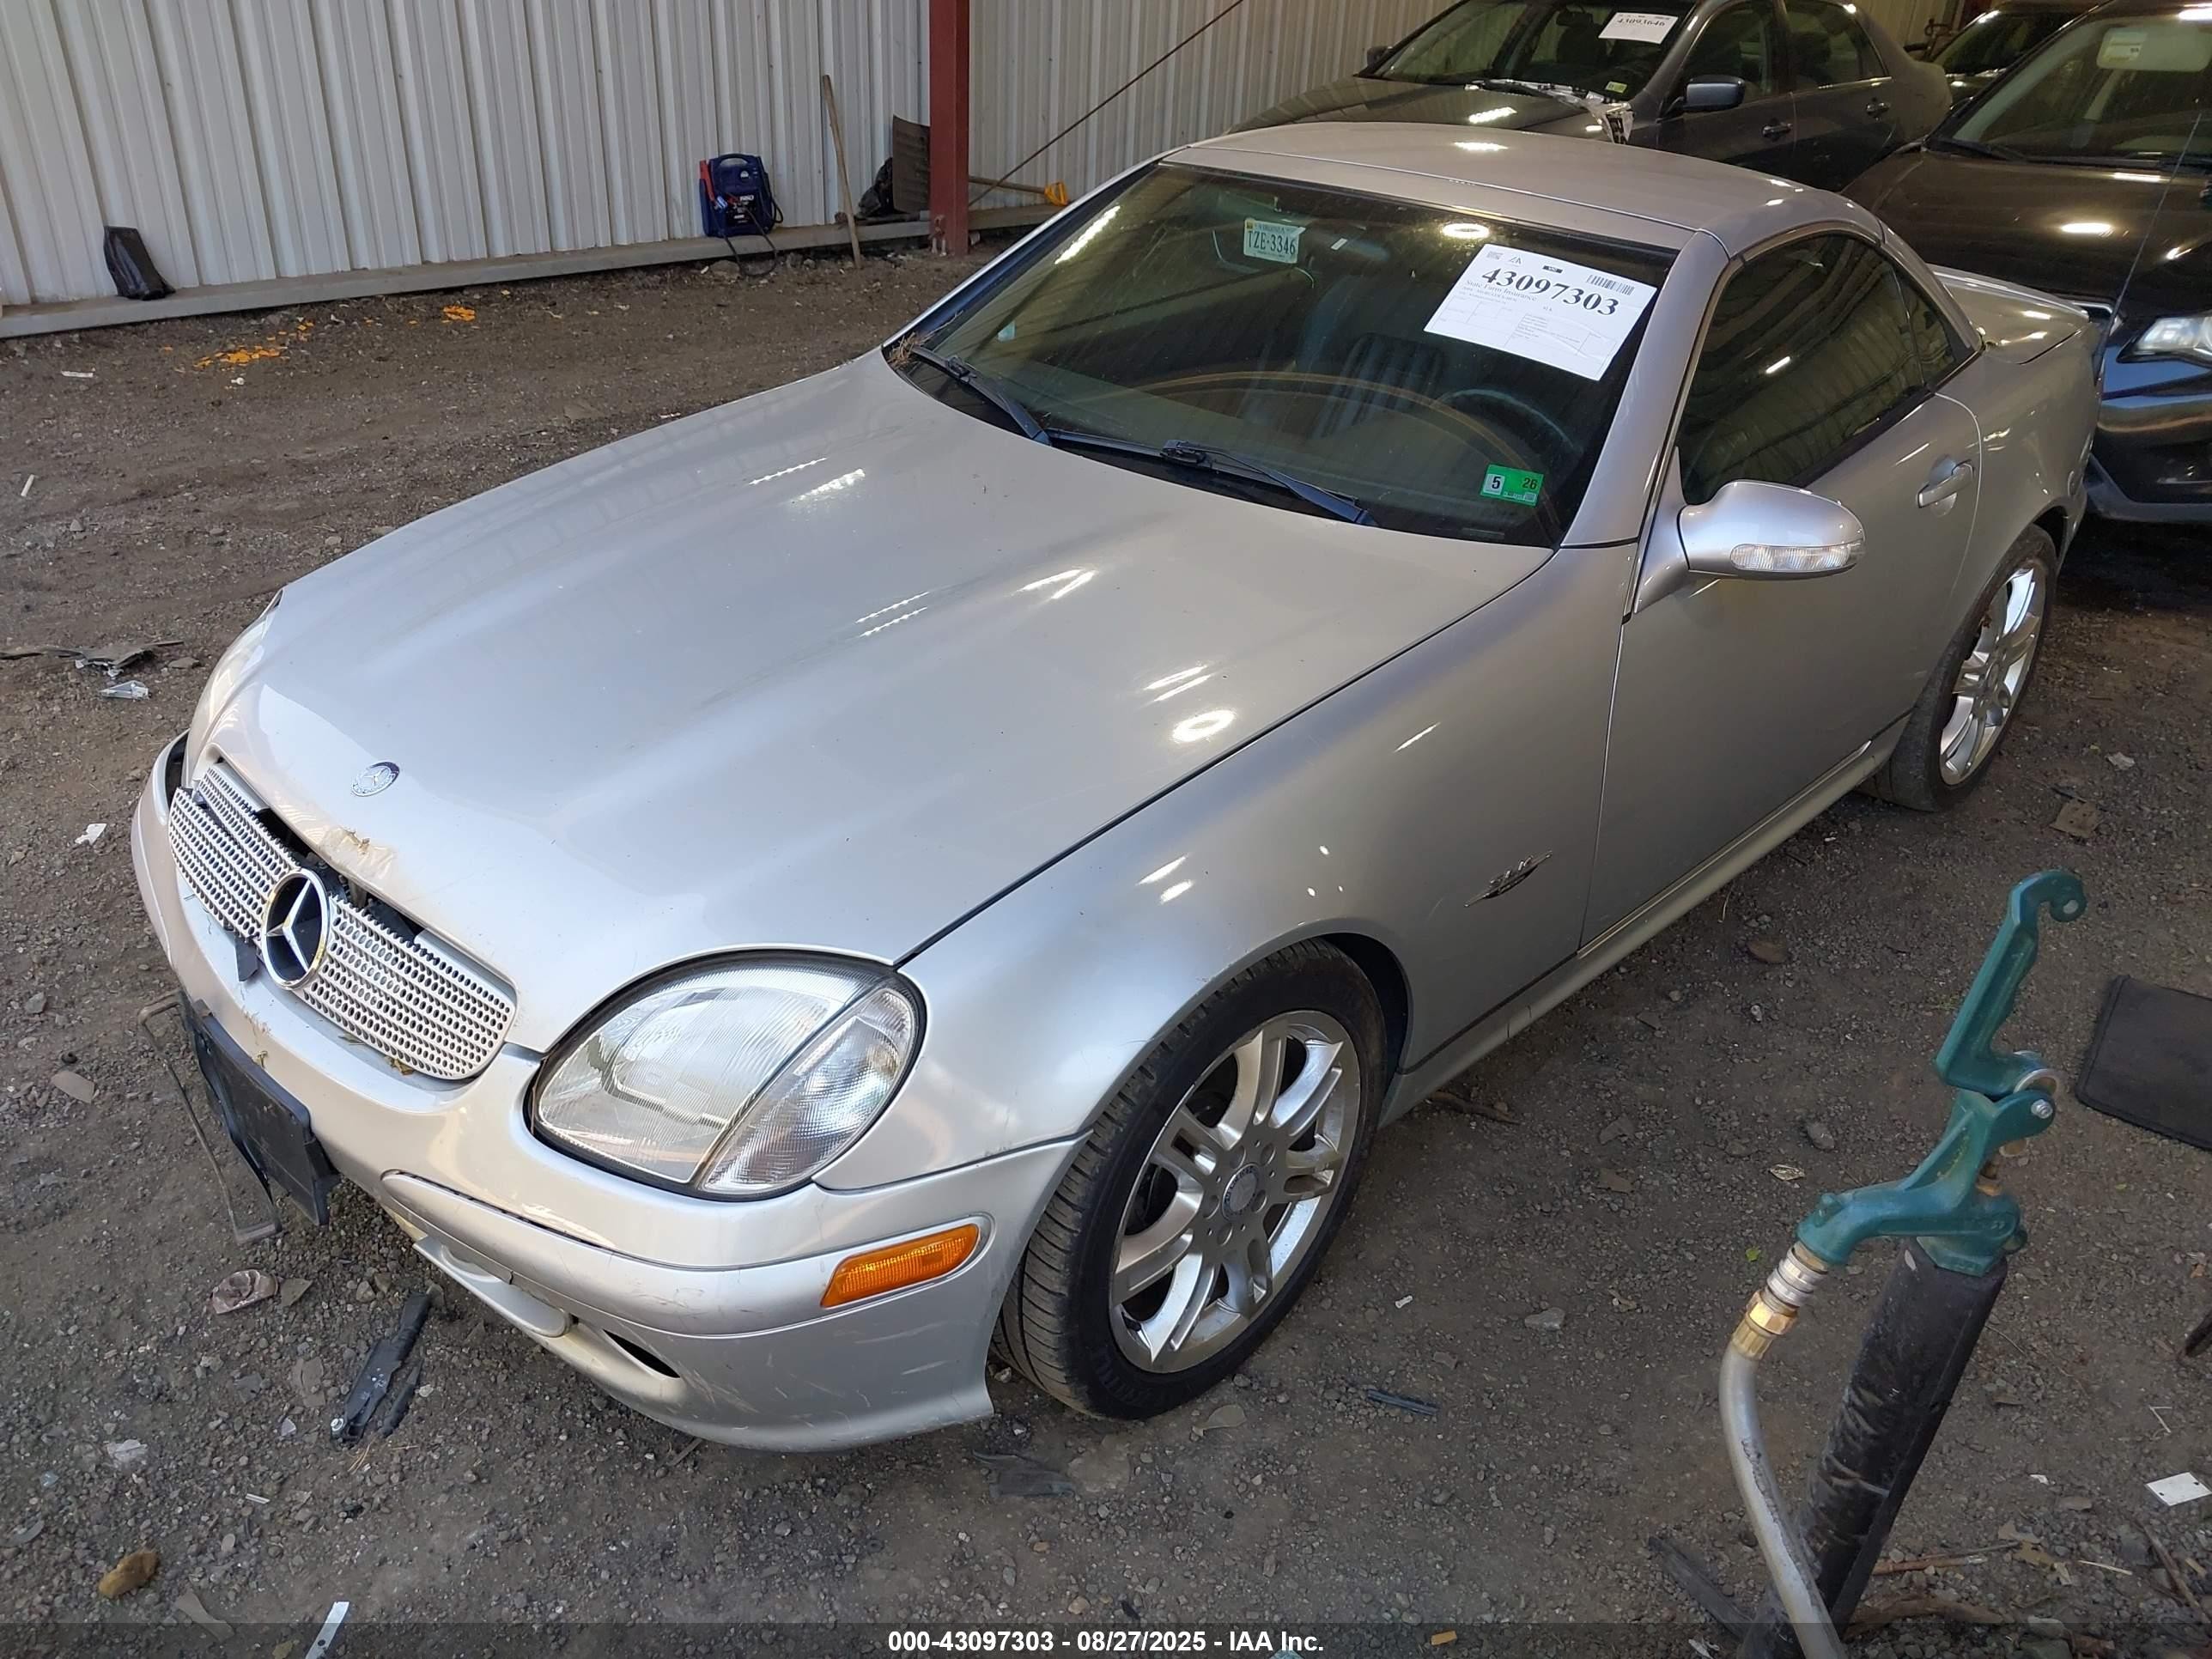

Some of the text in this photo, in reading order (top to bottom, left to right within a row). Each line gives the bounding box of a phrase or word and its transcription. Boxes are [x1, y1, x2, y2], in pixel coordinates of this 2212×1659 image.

[1481, 268, 1620, 316] 43097303
[1492, 476, 1501, 489] 5
[1522, 477, 1538, 489] 26
